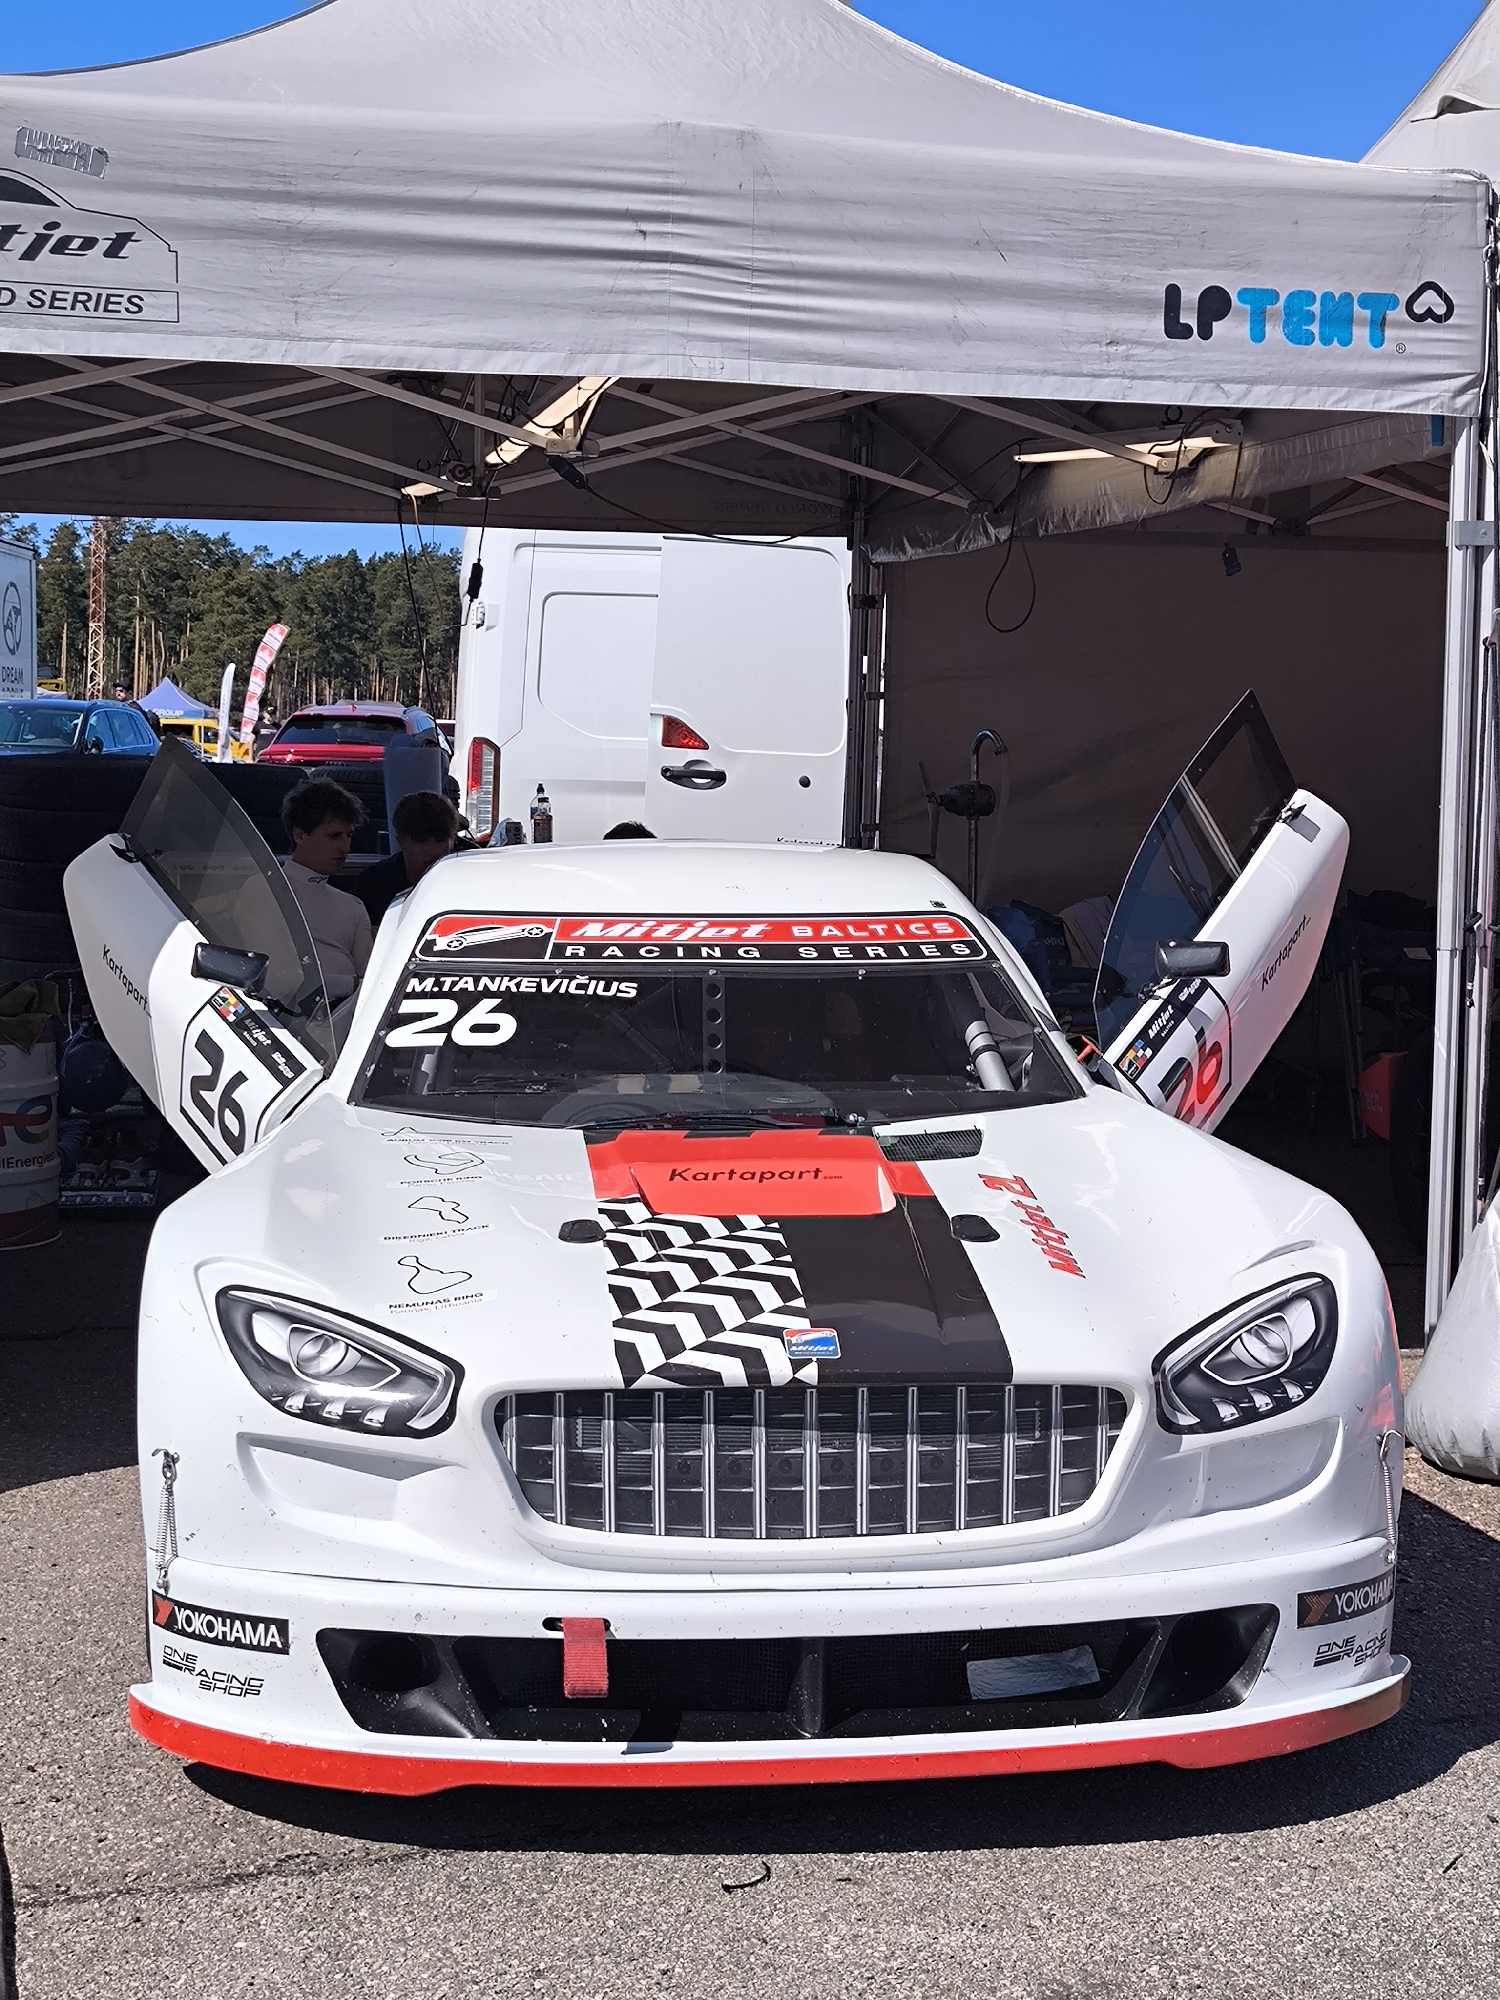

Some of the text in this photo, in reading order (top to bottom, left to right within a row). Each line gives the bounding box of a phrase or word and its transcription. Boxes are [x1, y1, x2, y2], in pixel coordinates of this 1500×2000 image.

[26, 288, 145, 315] SERIES
[2, 666, 24, 685] DREAM
[570, 920, 956, 941] Mitjet BALTICS
[564, 943, 972, 958] RACING SERIES
[405, 974, 640, 998] M.TANKEVIČIUS
[384, 998, 519, 1048] 26
[1157, 1026, 1223, 1128] 26
[190, 1028, 250, 1157] 26
[0, 1150, 56, 1170] lEnergies
[450, 1223, 490, 1234] TRACK
[1010, 1199, 1087, 1279] Mitjet
[388, 1292, 484, 1310] NEMUNAS RING
[173, 1605, 284, 1649] YOKOHAMA
[163, 1644, 198, 1666] ONE
[1316, 1634, 1357, 1656] ONE
[183, 1666, 265, 1689] RACING
[198, 1679, 263, 1698] SHOP
